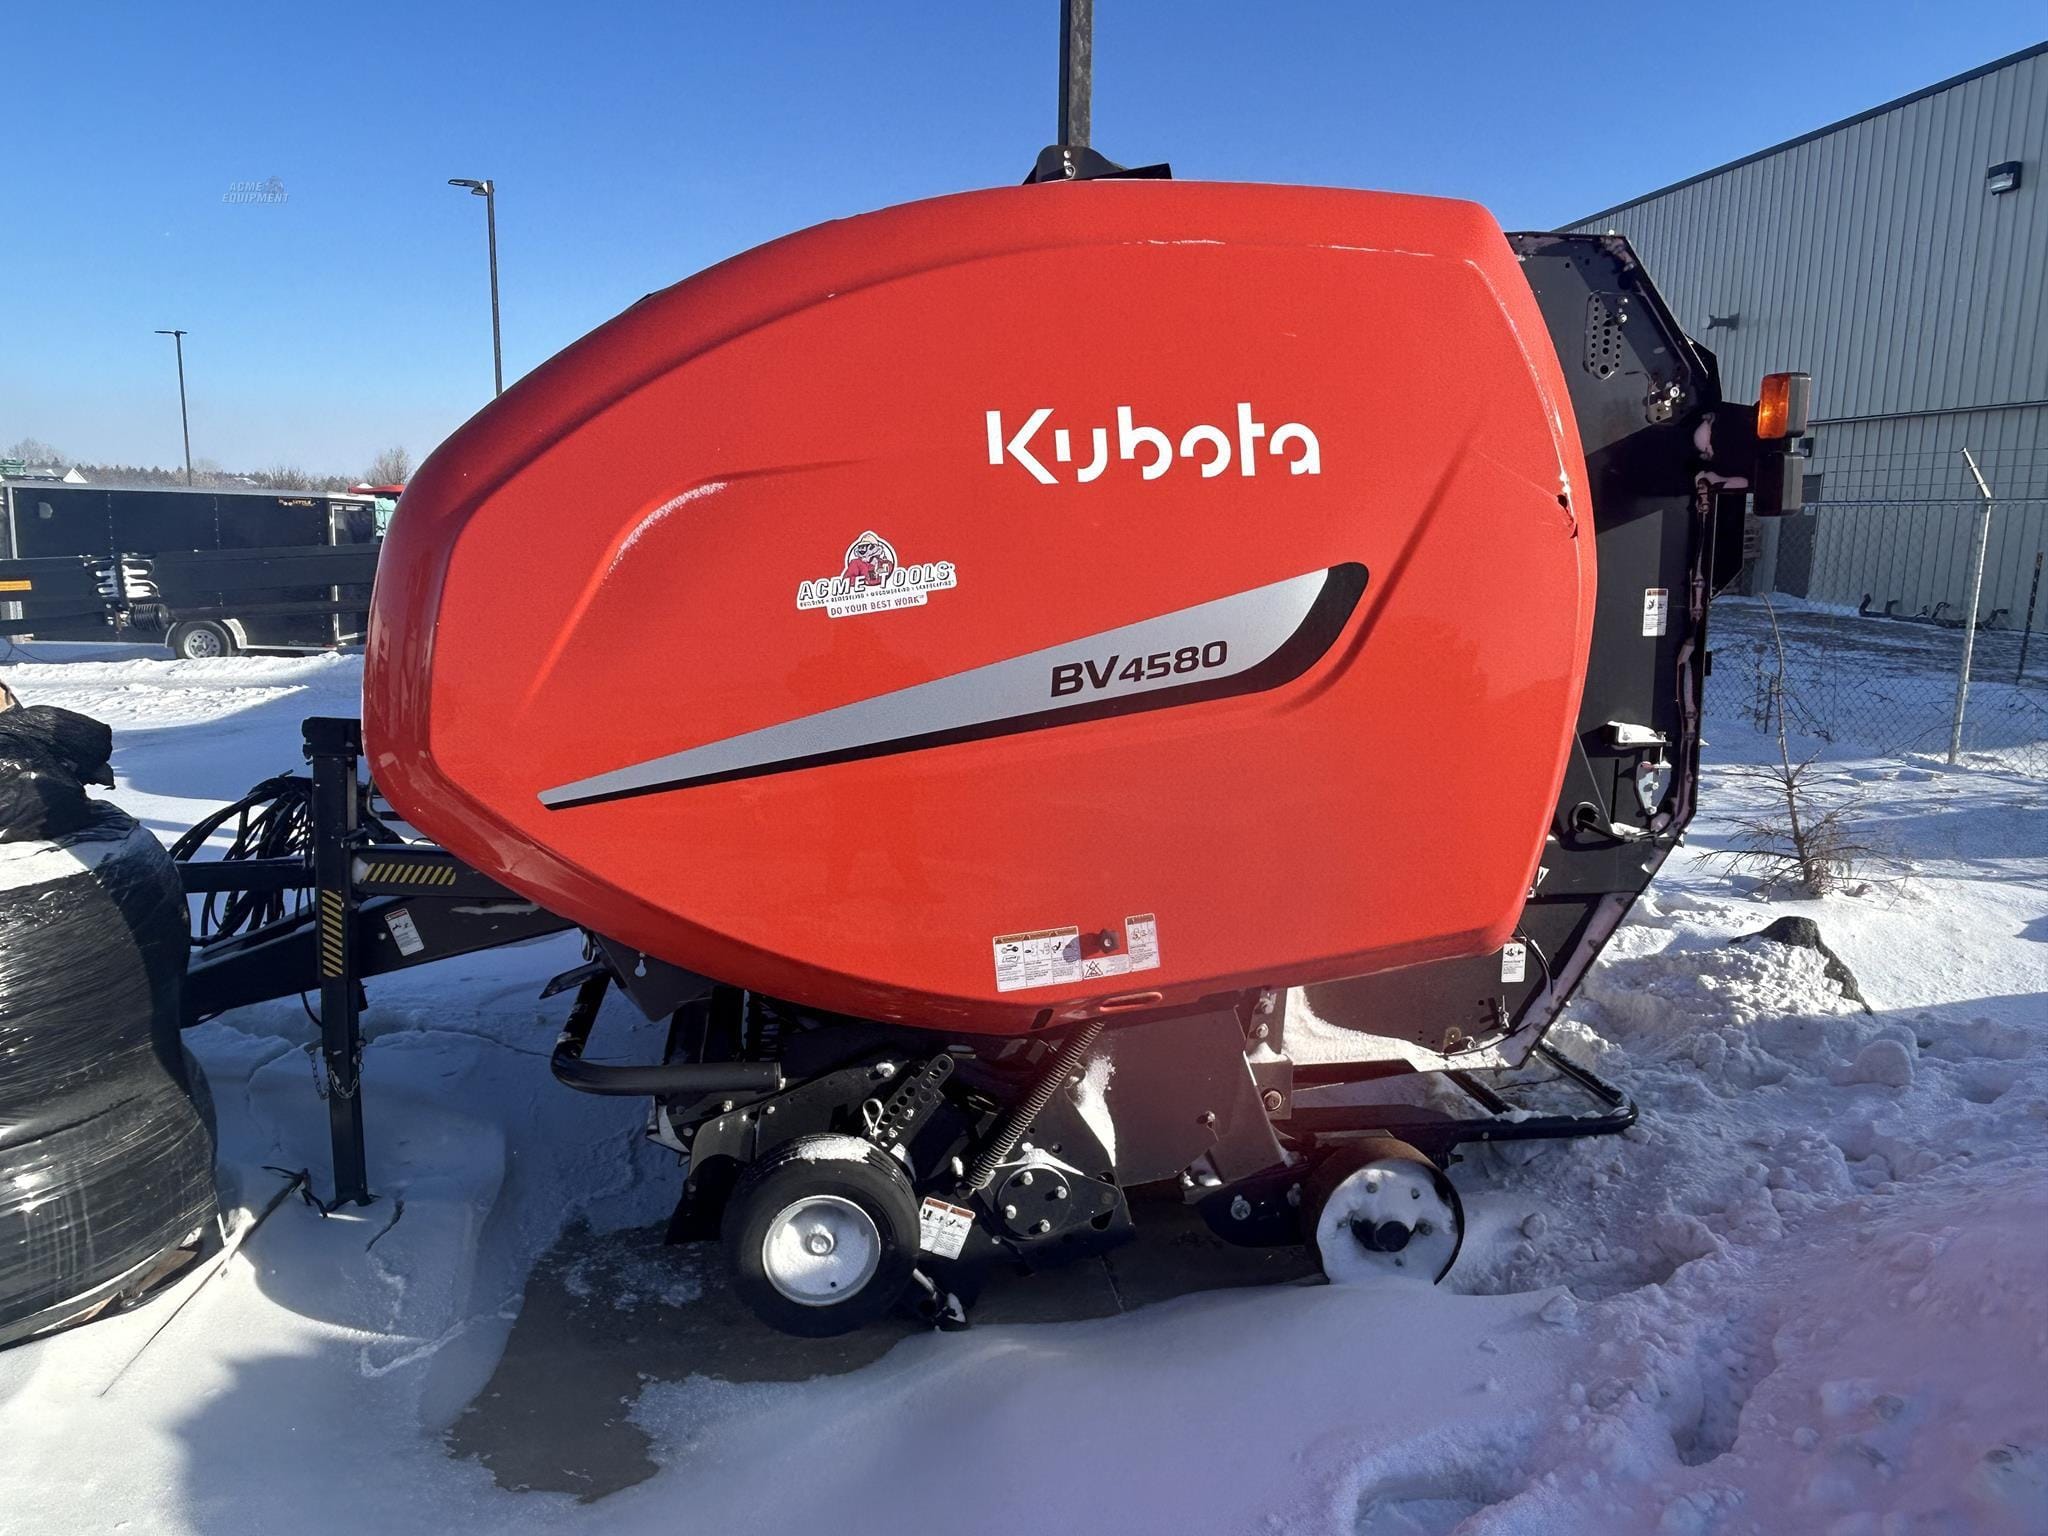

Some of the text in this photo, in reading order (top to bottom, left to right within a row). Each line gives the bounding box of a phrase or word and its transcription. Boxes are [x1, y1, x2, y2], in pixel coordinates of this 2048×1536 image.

[985, 401, 1322, 485] Kubota
[799, 562, 950, 601] ACME TOOLS
[830, 606, 843, 616] DO
[845, 602, 868, 614] YOUR
[870, 599, 892, 611] BEST
[1050, 640, 1228, 698] BV4580
